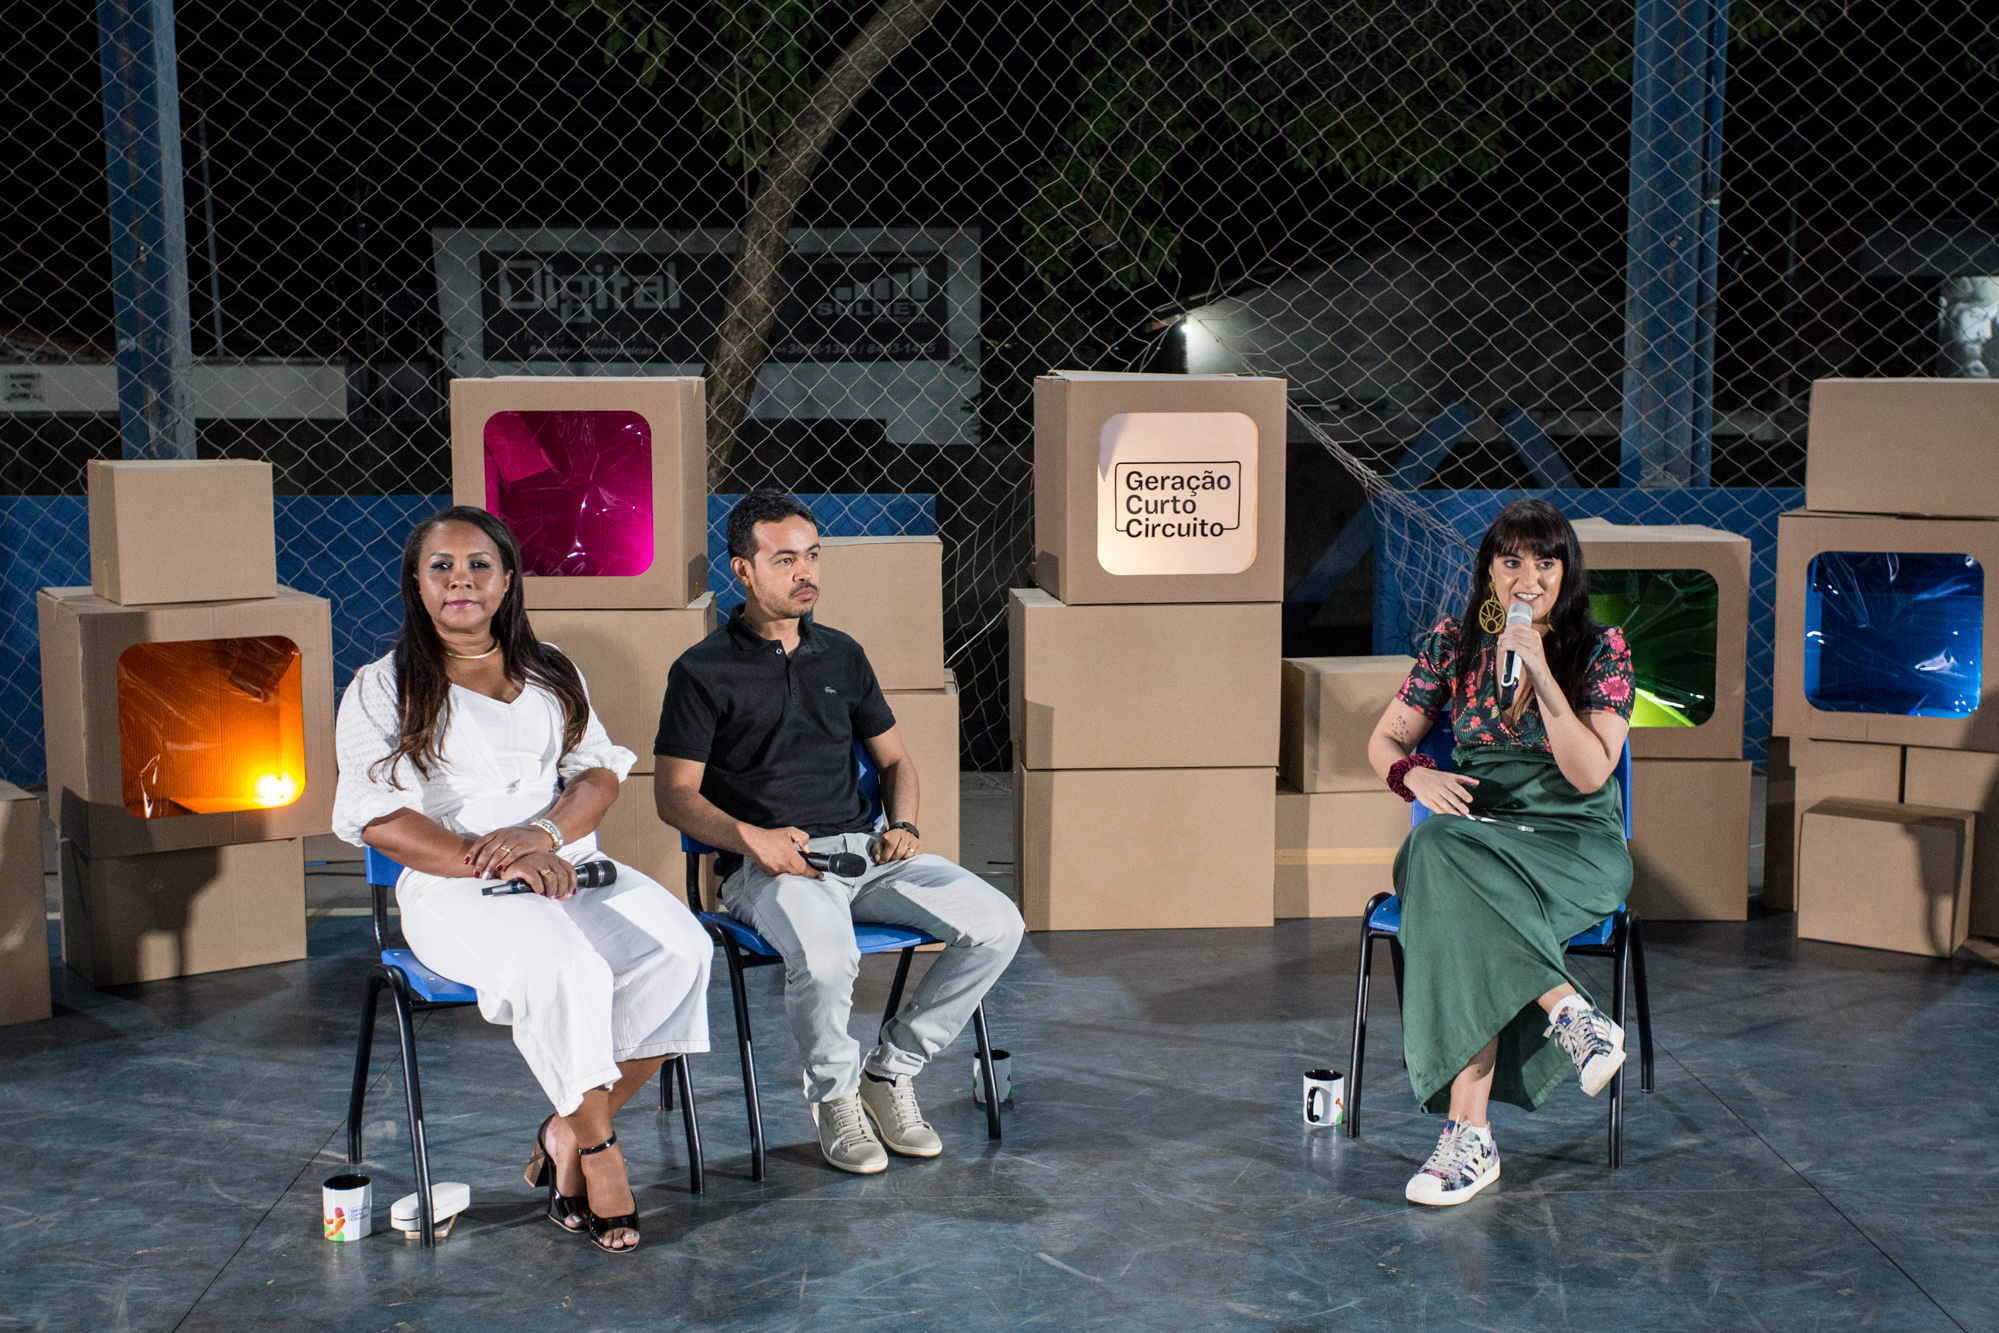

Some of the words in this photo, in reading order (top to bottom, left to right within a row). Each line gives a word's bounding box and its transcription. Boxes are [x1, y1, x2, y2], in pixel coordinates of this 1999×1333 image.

[498, 259, 681, 324] Digital
[1125, 470, 1231, 496] Geração
[1125, 494, 1197, 515] Curto
[1125, 517, 1224, 538] Circuito
